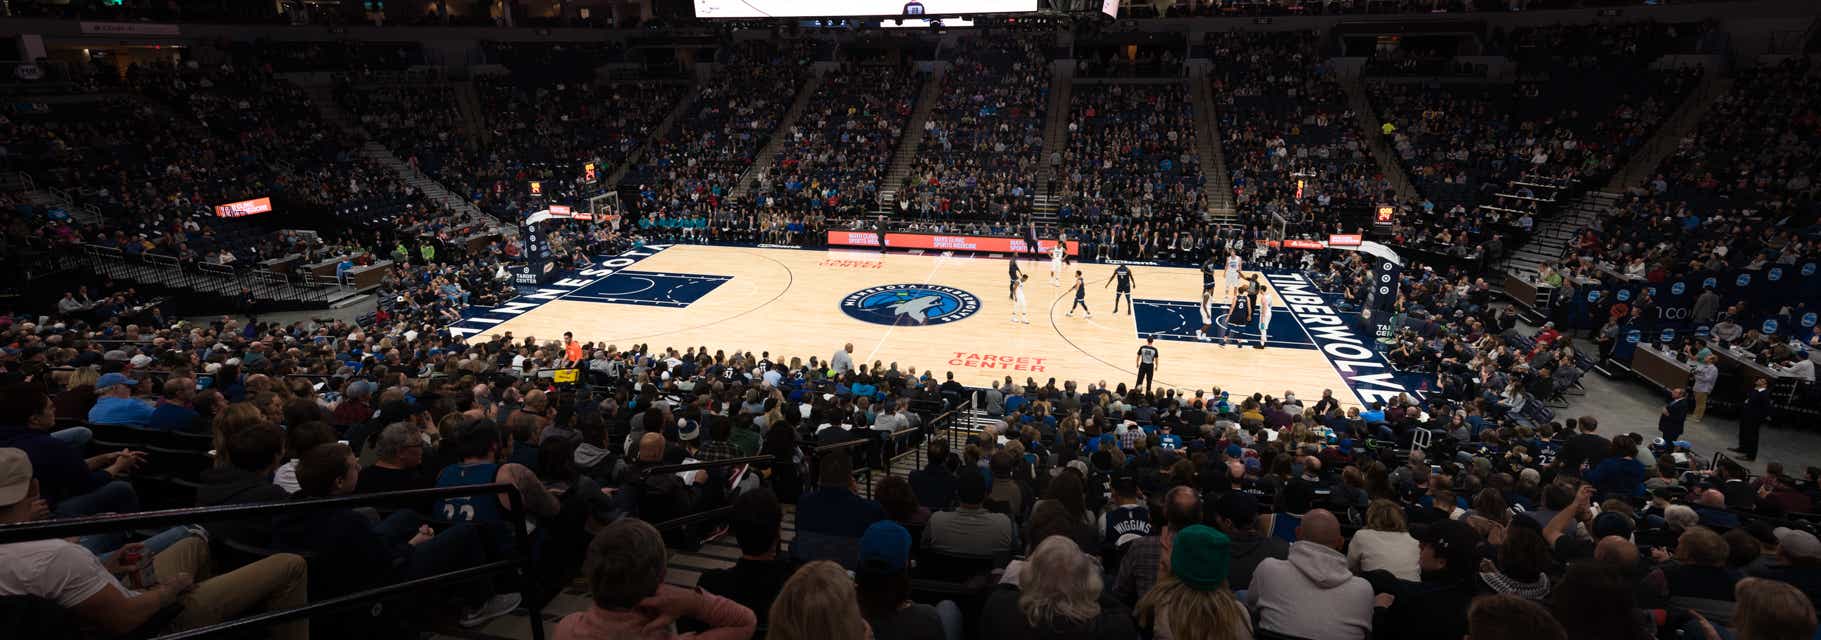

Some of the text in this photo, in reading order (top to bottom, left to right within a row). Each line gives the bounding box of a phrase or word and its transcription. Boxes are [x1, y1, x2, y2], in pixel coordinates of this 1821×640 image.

[1267, 272, 1428, 422] TIMBERWOLVE
[948, 359, 1046, 373] CENTER
[953, 352, 1047, 365] TARGET
[1112, 519, 1153, 535] WIGGINS
